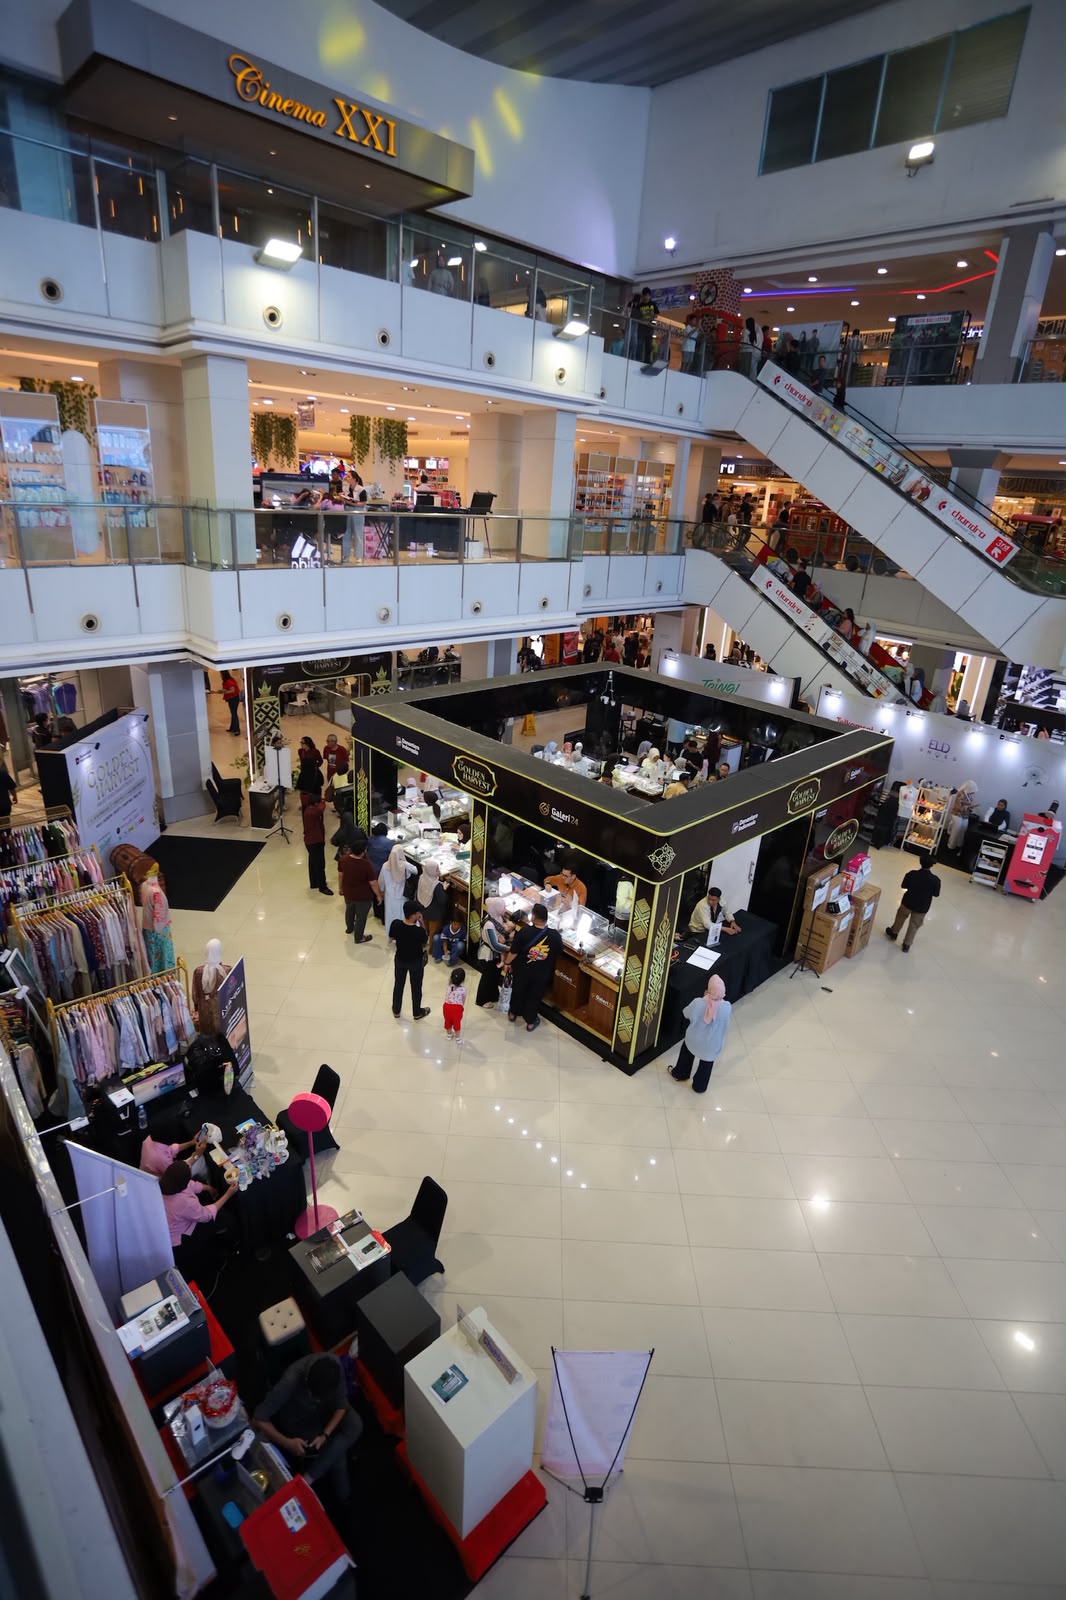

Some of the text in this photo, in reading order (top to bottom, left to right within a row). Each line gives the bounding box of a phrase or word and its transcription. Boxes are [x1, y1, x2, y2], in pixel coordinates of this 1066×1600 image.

[228, 54, 397, 157] Cinema XXI
[784, 382, 813, 407] chandra
[951, 510, 986, 539] chandra
[995, 539, 1010, 551] 3rd
[775, 589, 802, 614] chandra
[87, 748, 134, 788] GOLDEN
[96, 757, 140, 800] HARVEST
[458, 762, 485, 781] GOLDEN
[463, 772, 491, 791] HARVEST
